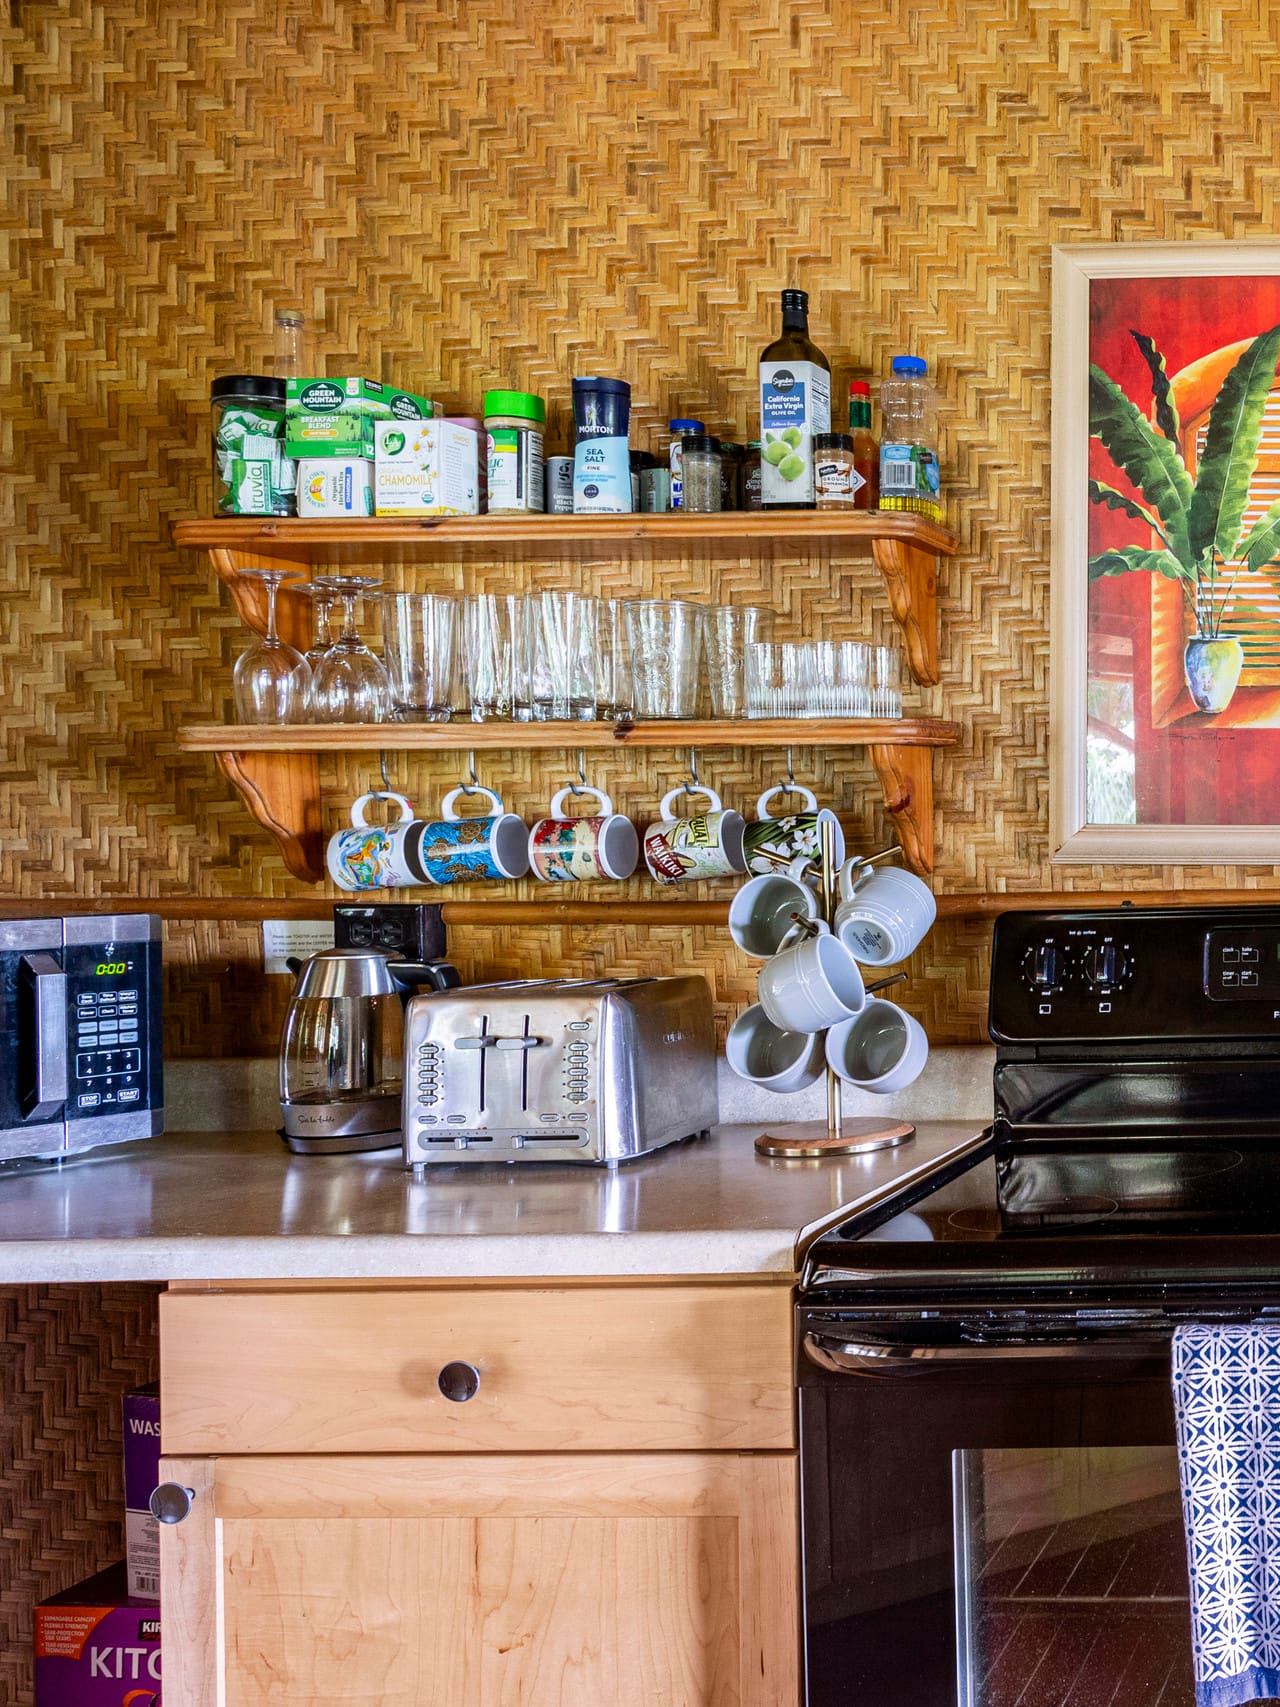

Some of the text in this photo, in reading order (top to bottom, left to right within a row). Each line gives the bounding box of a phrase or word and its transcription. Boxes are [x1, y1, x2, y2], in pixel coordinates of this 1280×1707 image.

[396, 402, 416, 412] GREEN
[579, 426, 613, 434] MORTON
[379, 474, 432, 486] CHAMOMILE
[650, 836, 683, 876] WAIKIKI
[96, 963, 126, 975] 0:00
